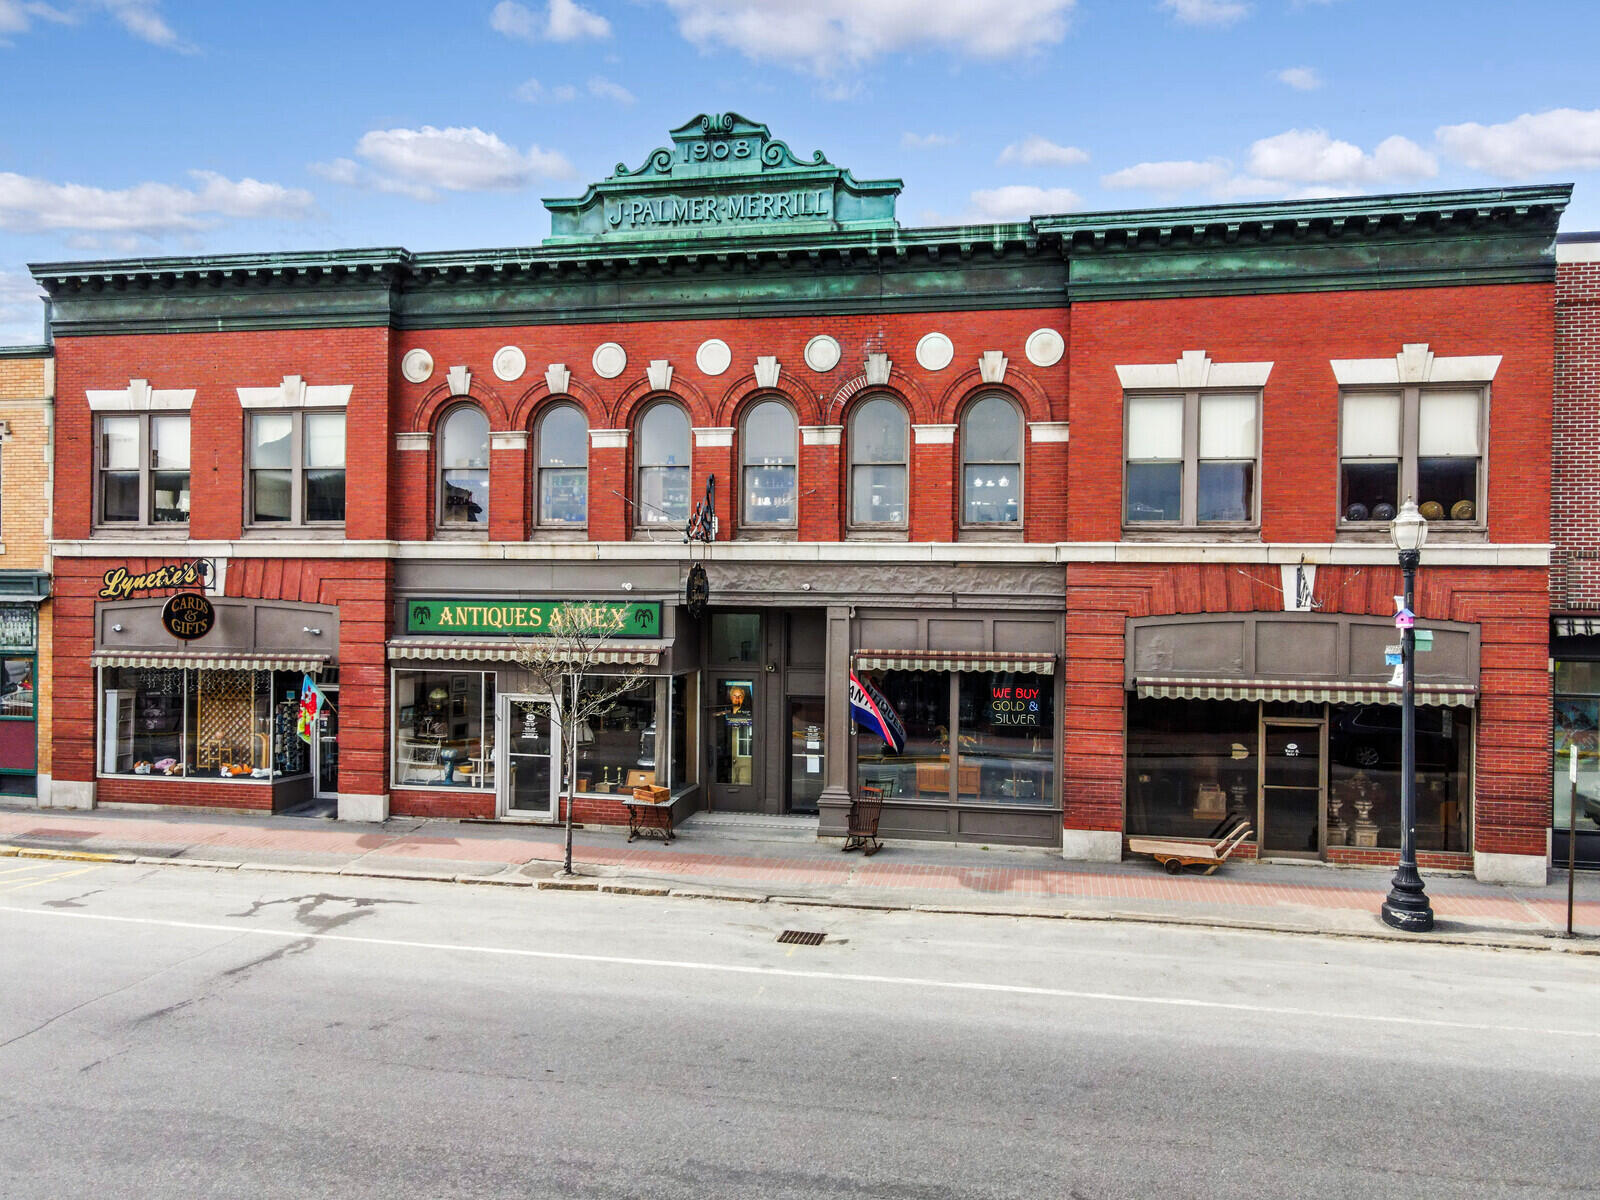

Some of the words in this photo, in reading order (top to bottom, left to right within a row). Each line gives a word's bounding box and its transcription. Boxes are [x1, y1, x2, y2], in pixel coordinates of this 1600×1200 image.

[683, 140, 751, 162] 1908
[171, 596, 209, 614] CARDS
[184, 609, 198, 622] &
[438, 606, 542, 628] ANTIQUES
[548, 607, 625, 628] ANNEX
[171, 618, 208, 635] GIFTS
[992, 687, 1012, 699] WE
[1015, 687, 1040, 699] BUY
[992, 700, 1026, 711] GOLD
[1028, 700, 1039, 711] &
[994, 713, 1036, 725] SILVER
